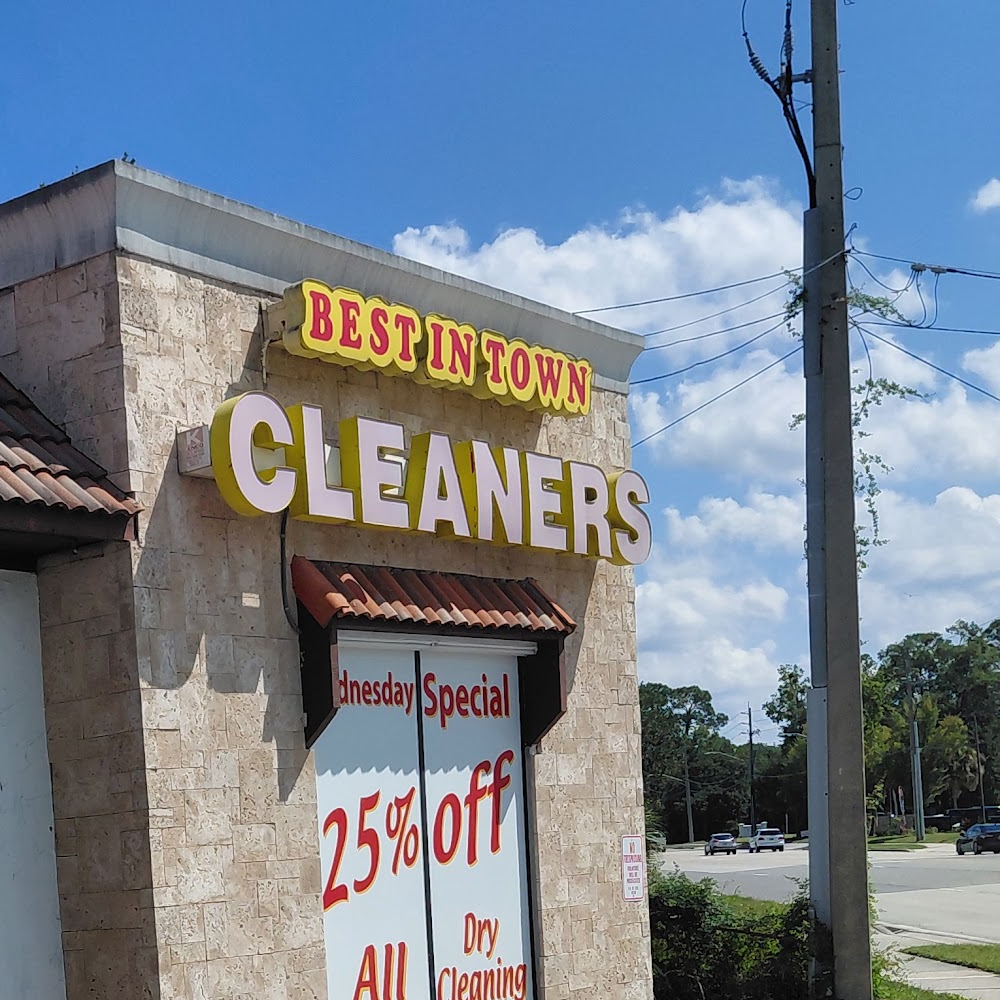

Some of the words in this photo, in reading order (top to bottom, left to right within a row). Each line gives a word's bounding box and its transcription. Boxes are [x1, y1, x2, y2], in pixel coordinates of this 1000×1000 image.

[309, 290, 416, 363] BEST
[430, 322, 475, 378] IN
[485, 339, 589, 407] TOWN
[229, 392, 652, 565] CLEANERS
[423, 672, 511, 728] Special
[322, 786, 420, 912] 25%
[433, 749, 515, 867] off
[464, 912, 500, 959] Dry
